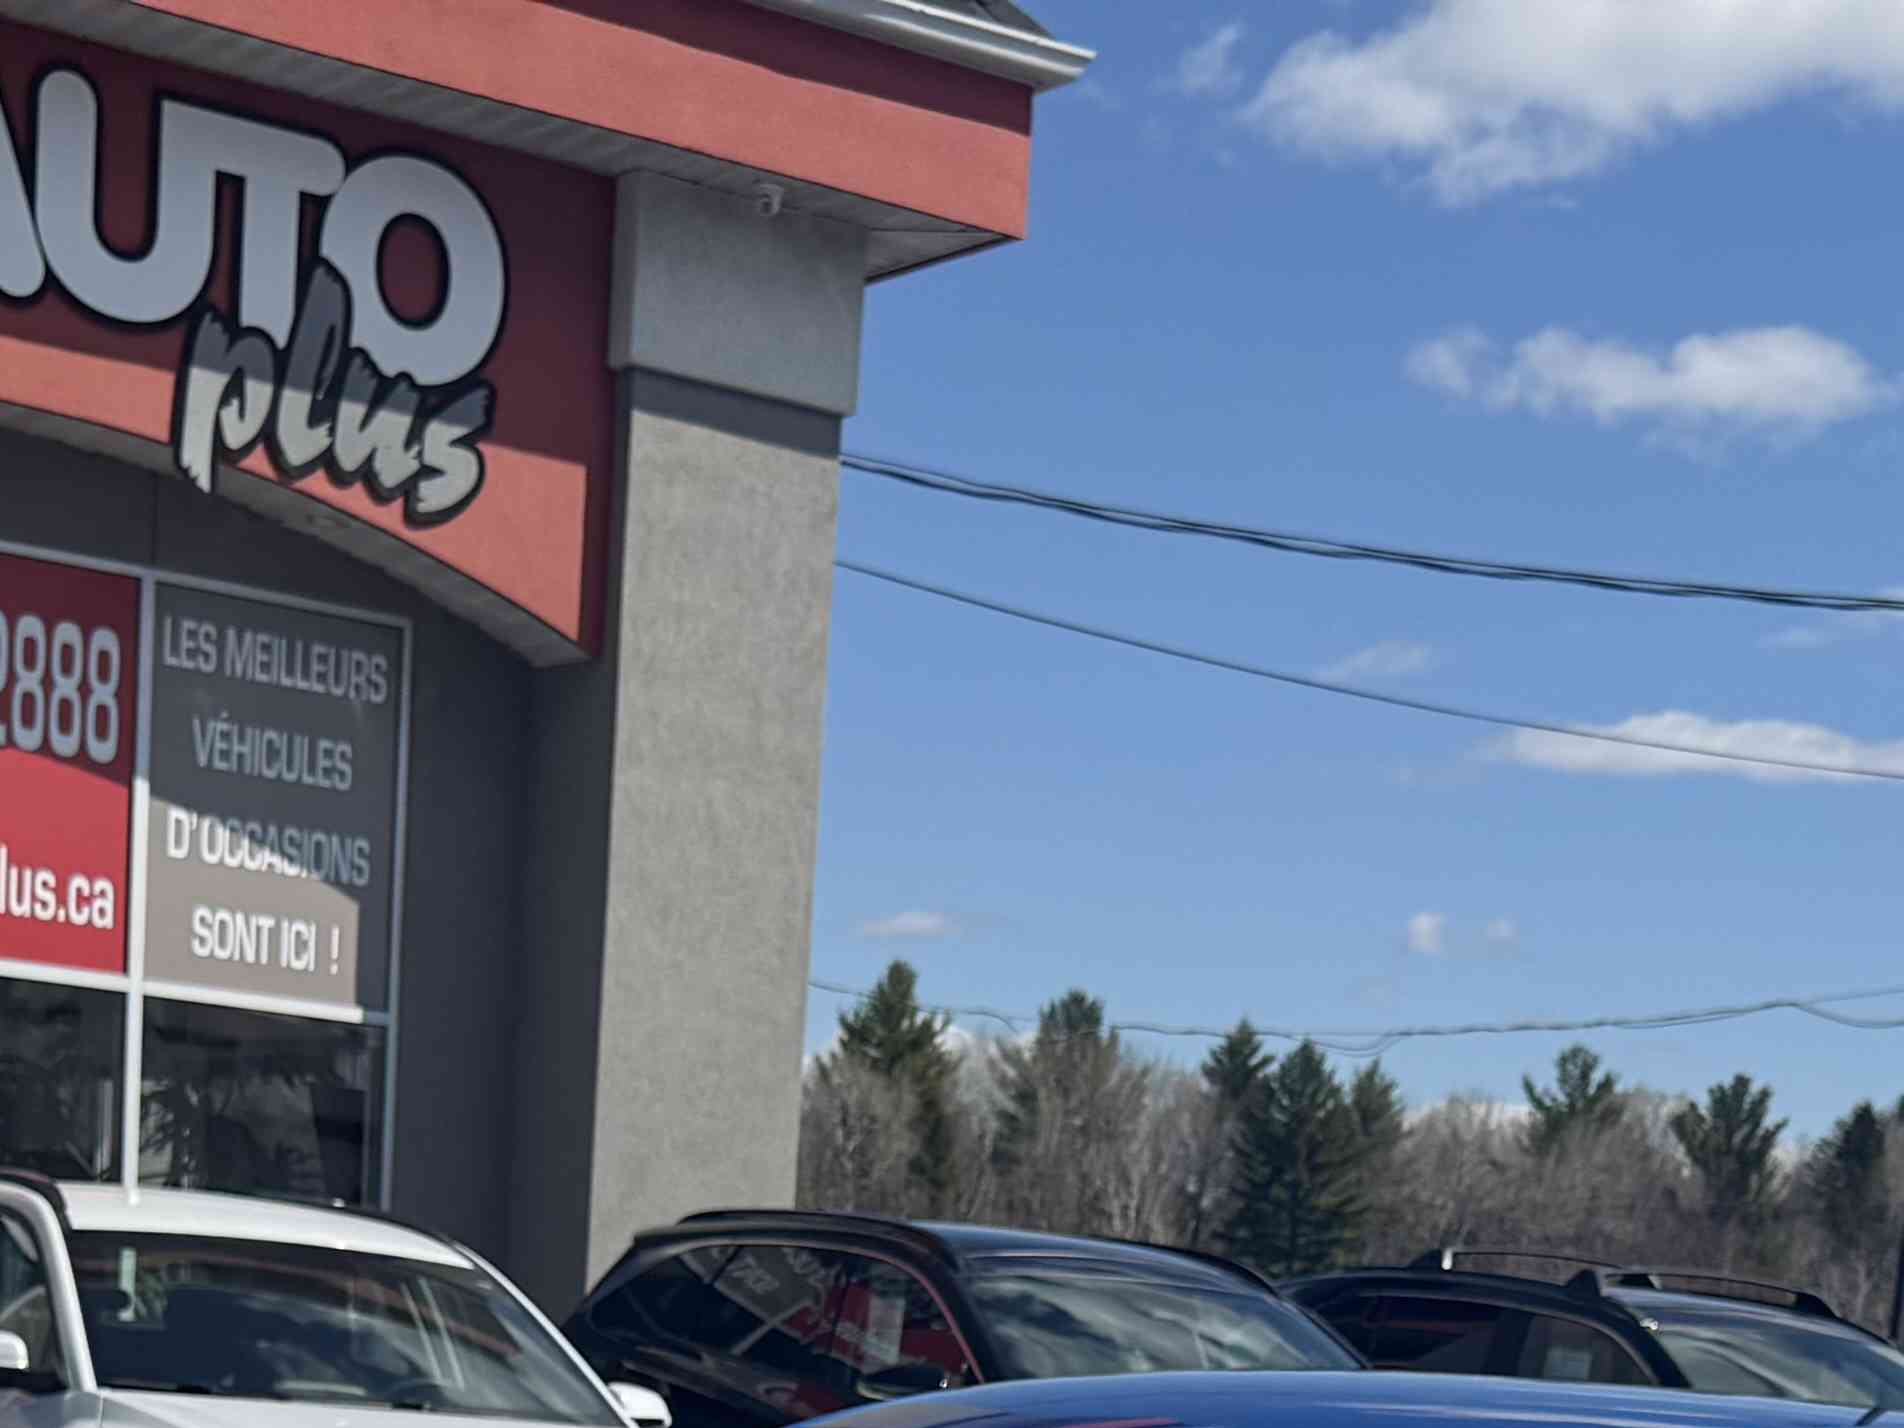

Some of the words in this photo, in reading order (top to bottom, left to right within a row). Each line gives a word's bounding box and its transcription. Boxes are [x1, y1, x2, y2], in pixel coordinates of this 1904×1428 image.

[176, 258, 493, 524] plus
[163, 615, 217, 674] LES
[224, 625, 388, 704] MEILLEURS
[193, 710, 352, 792] VÉHICULES
[166, 806, 371, 887] D'OCCASIONS
[191, 905, 275, 966] SONT
[280, 921, 316, 972] ICI
